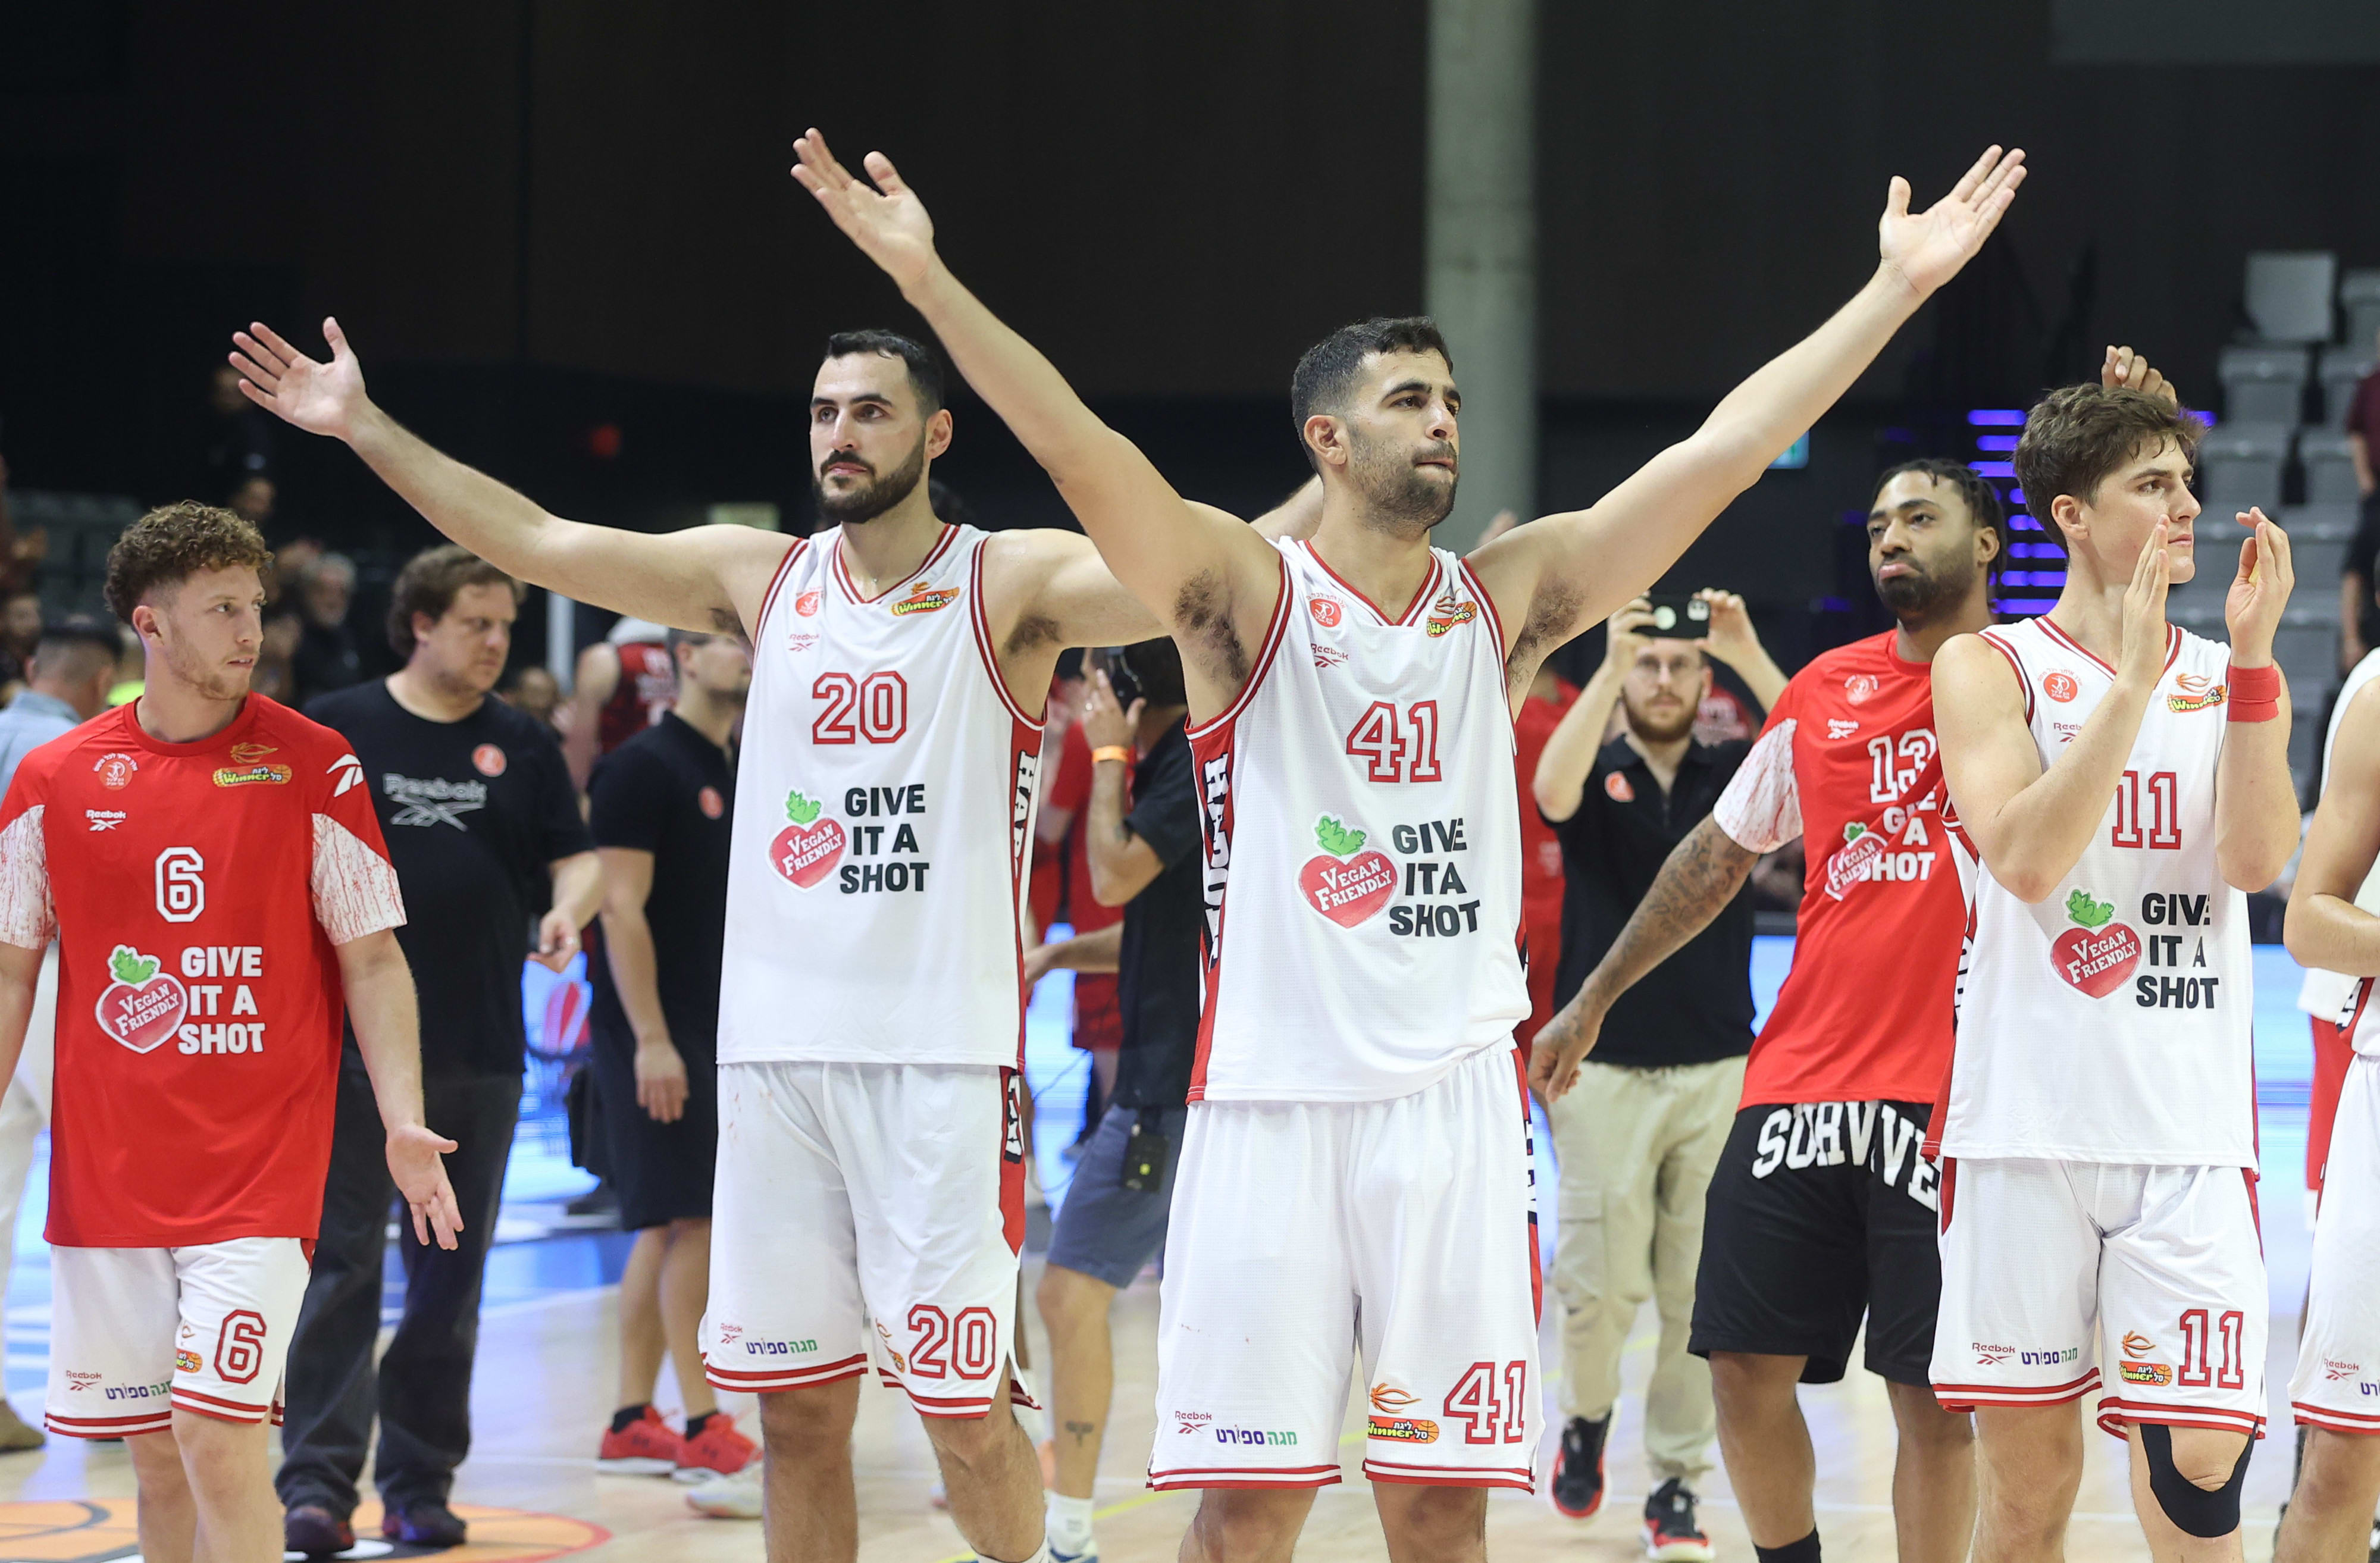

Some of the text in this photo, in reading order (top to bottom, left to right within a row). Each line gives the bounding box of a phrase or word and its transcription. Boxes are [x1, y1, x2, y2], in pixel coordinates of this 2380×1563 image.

[898, 601, 943, 614] Winner
[1310, 643, 1349, 660] Reebok
[812, 671, 907, 744] 20
[1345, 699, 1442, 783] 41
[2053, 722, 2082, 731] Reeb
[223, 773, 270, 784] Winner
[1867, 728, 1937, 804] 13
[86, 809, 127, 819] Reebok
[845, 784, 925, 817] GIVE
[2112, 770, 2181, 850] 11
[787, 823, 835, 856] VEGAN
[853, 823, 919, 855] IT A
[1392, 817, 1467, 854] GIVE
[1902, 817, 1928, 845] A
[782, 833, 843, 876] FRIENDLY
[155, 846, 205, 923] 6
[840, 863, 929, 894] SHOT
[1314, 869, 1392, 912] FRIENDLY
[1320, 858, 1382, 891] VEGAN
[1389, 899, 1480, 937] SHOT
[181, 946, 262, 977] GIVE
[2066, 941, 2137, 983] FRIENDLY
[2071, 930, 2128, 962] VEGAN
[2150, 935, 2206, 967] IT A
[118, 983, 171, 1016] VEGAN
[190, 985, 258, 1016] IT A
[2136, 975, 2219, 1008] SHOT
[114, 992, 180, 1036] FRIENDLY
[178, 1023, 265, 1054] SHOT
[214, 1309, 267, 1385] 6
[788, 1339, 818, 1354] מגה
[907, 1304, 996, 1380] 20
[1972, 1342, 2015, 1353] Reebok
[2060, 1347, 2078, 1362] מגה
[2178, 1309, 2243, 1390] 11
[67, 1370, 102, 1379] Reebok
[2154, 1372, 2164, 1382] סל
[2324, 1358, 2360, 1371] Reebok
[1175, 1411, 1212, 1421] Reebok
[1443, 1360, 1526, 1444] 41
[1267, 1432, 1297, 1445] מגה
[1393, 1420, 1413, 1430] ליגת
[1414, 1428, 1427, 1439] סל
